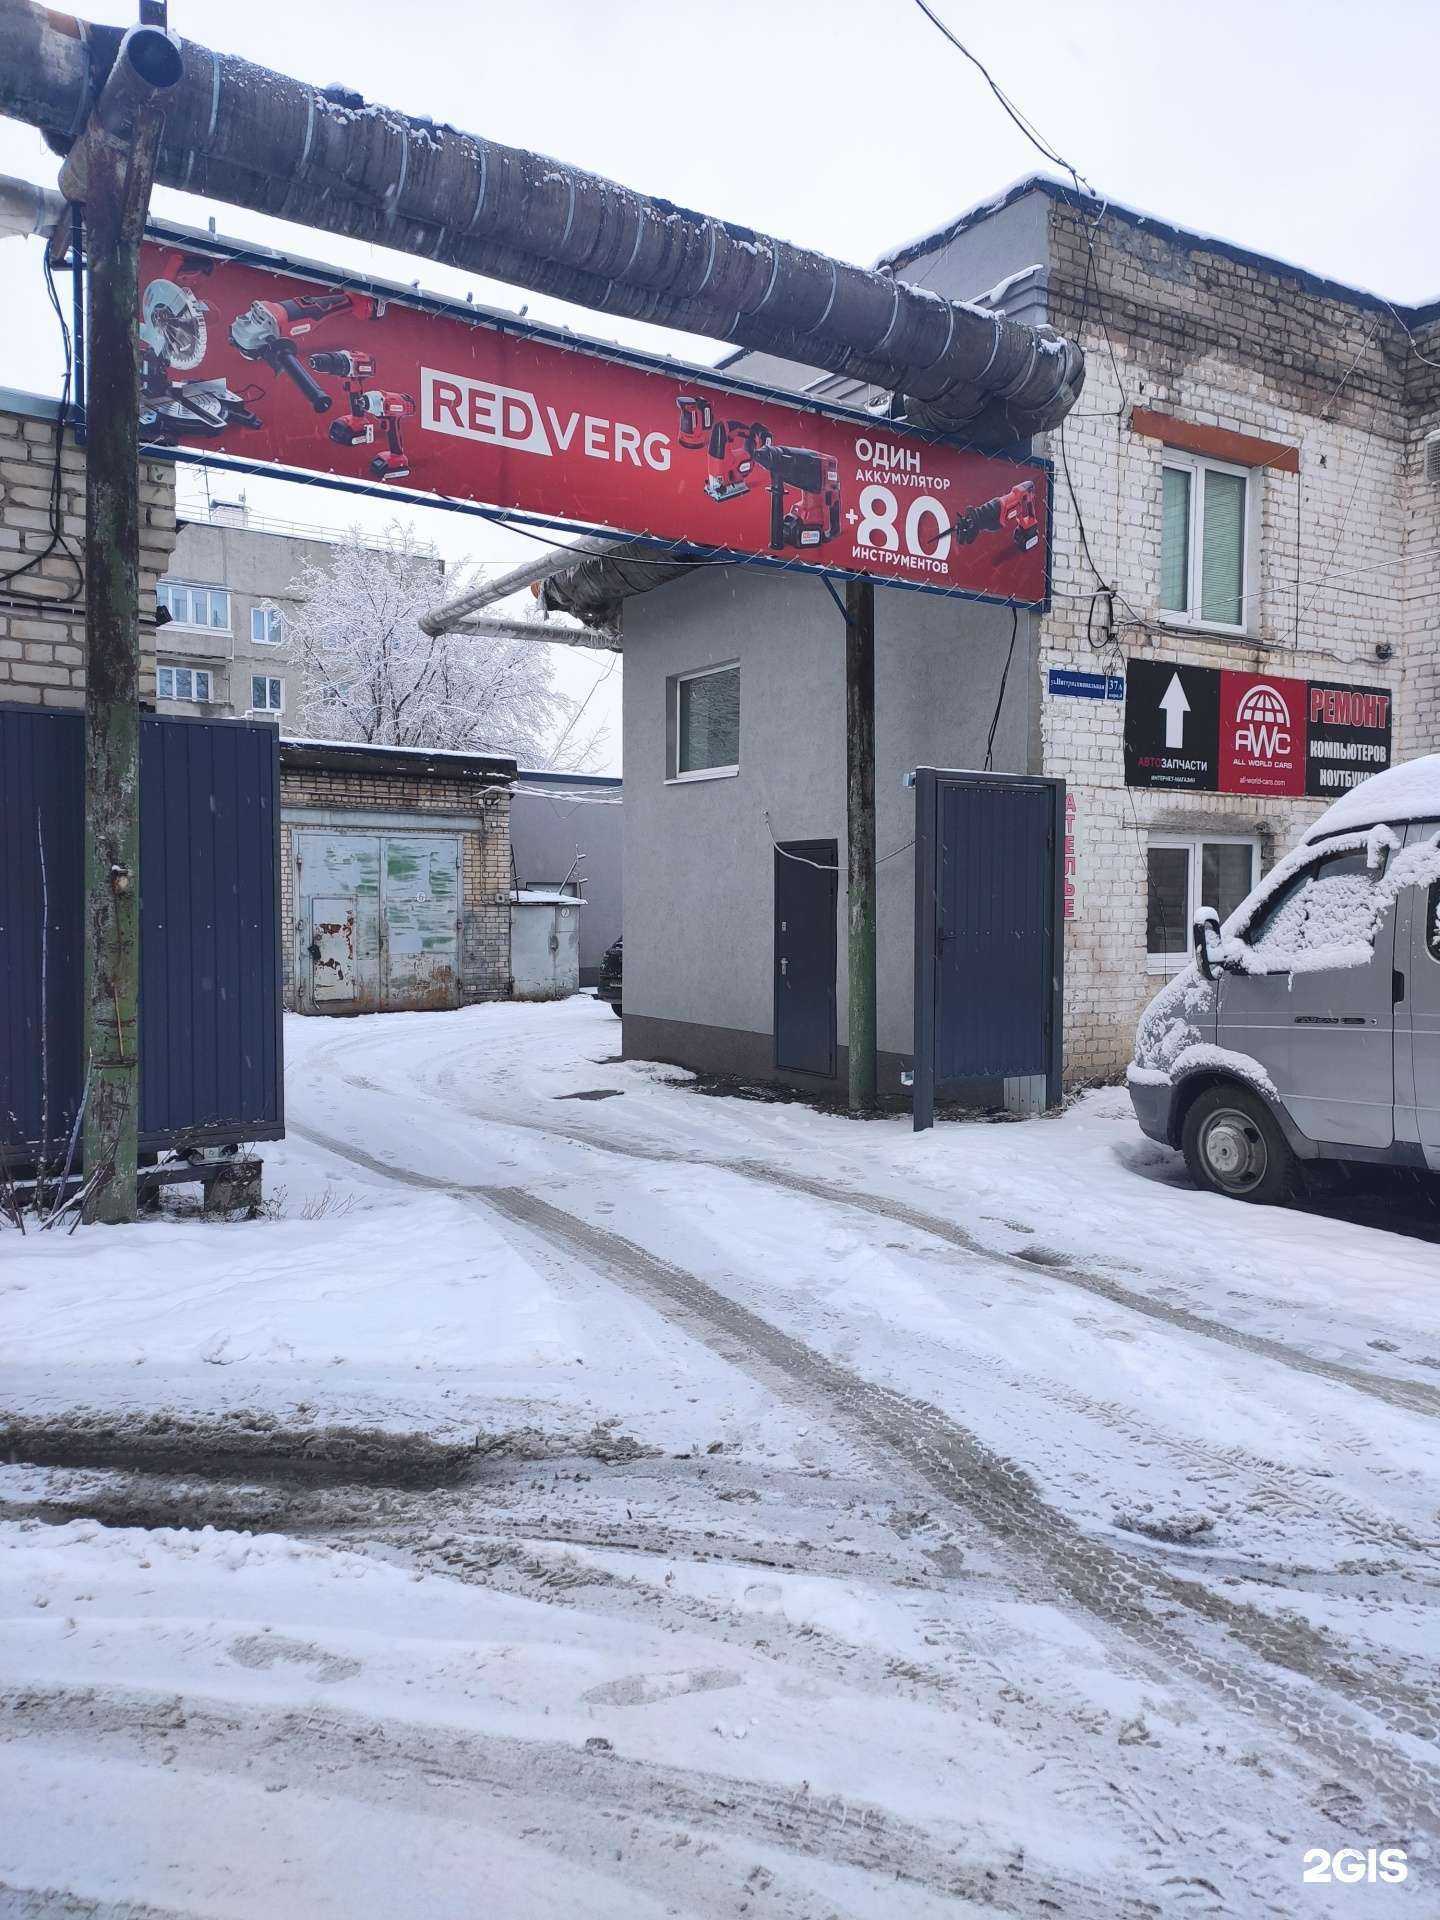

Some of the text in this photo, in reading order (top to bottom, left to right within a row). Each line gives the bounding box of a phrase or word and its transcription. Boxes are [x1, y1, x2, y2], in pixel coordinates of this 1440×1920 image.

[430, 376, 672, 472] REDVERG
[855, 438, 921, 473] ОДИН
[855, 470, 951, 490] АККУМУЛЯТОР
[852, 545, 949, 574] ИНСТРУМЕНТОВ
[1310, 688, 1389, 729] РЕМОНТ
[1235, 723, 1291, 759] AWC
[1310, 740, 1387, 763] КОМПЬЮТЕРОВ
[1136, 757, 1208, 771] АВТОЗАПЧАСТИ
[1233, 758, 1293, 769] ALL WORLD CARS
[1064, 792, 1077, 918] АТЕЛЬЕ
